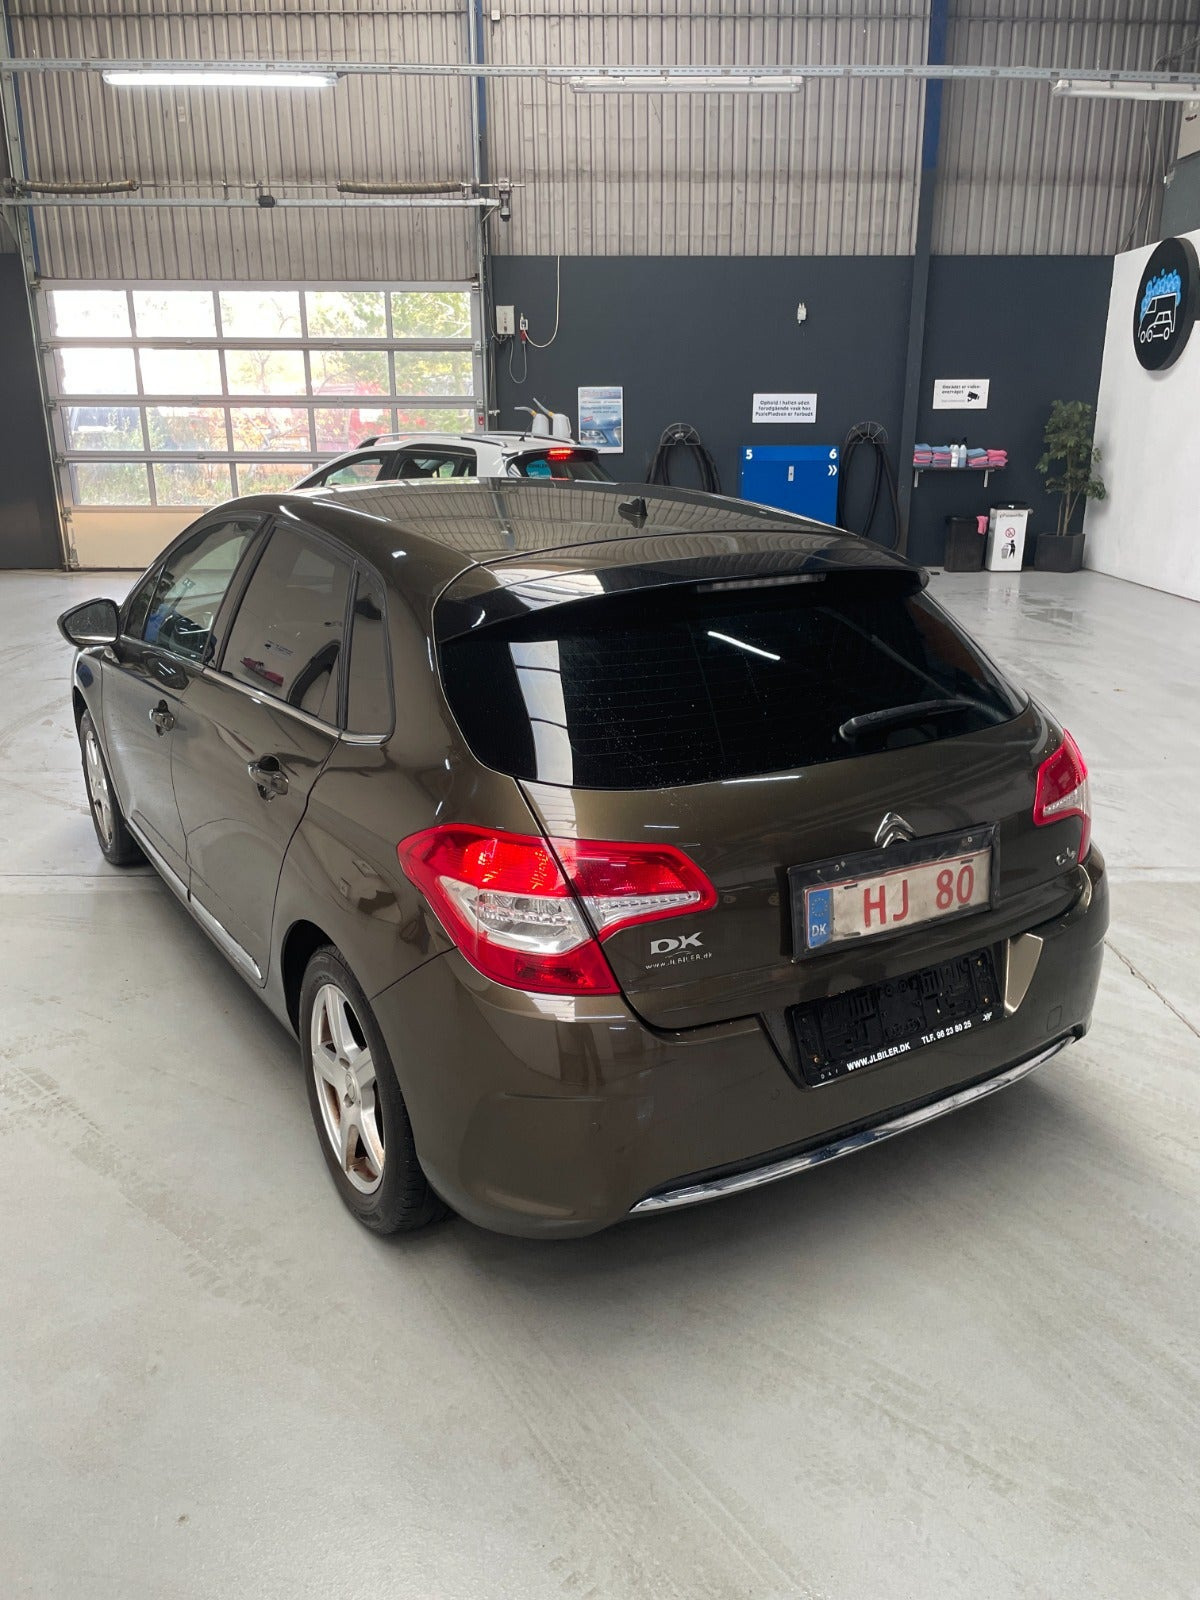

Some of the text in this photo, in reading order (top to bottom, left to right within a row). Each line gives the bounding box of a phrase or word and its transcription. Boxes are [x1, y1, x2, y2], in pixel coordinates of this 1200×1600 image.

[746, 449, 753, 460] 5
[829, 449, 837, 459] 6
[864, 865, 975, 928] HJ 80
[811, 922, 828, 937] DK
[651, 931, 704, 955] DK
[846, 1042, 911, 1071] WWW.JLBILER.DK
[921, 1034, 936, 1045] TLF.
[946, 1026, 954, 1036] 23
